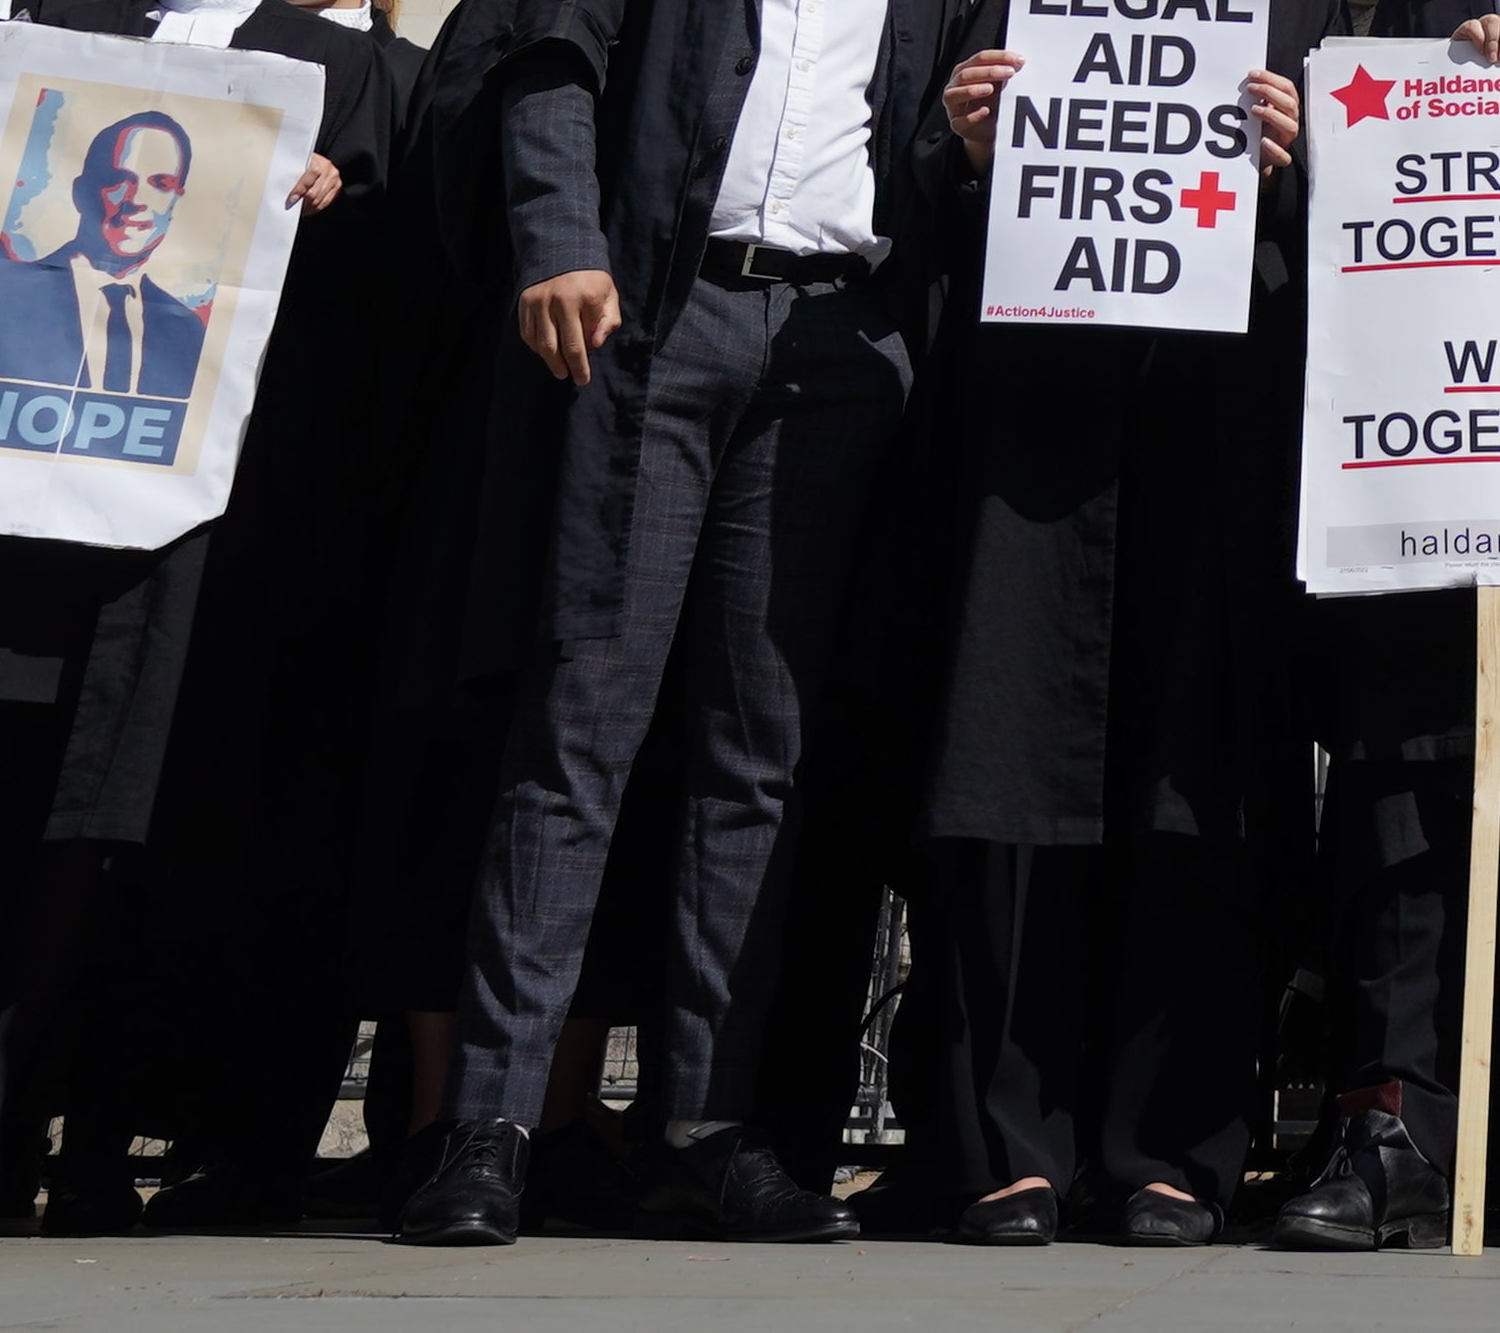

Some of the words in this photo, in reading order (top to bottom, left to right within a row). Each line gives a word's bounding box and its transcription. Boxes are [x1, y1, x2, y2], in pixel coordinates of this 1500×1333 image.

[1072, 32, 1197, 87] AID
[1011, 95, 1249, 160] NEEDS
[1395, 99, 1419, 120] of
[1053, 236, 1182, 295] AID
[985, 304, 1096, 320] #Action4Justice
